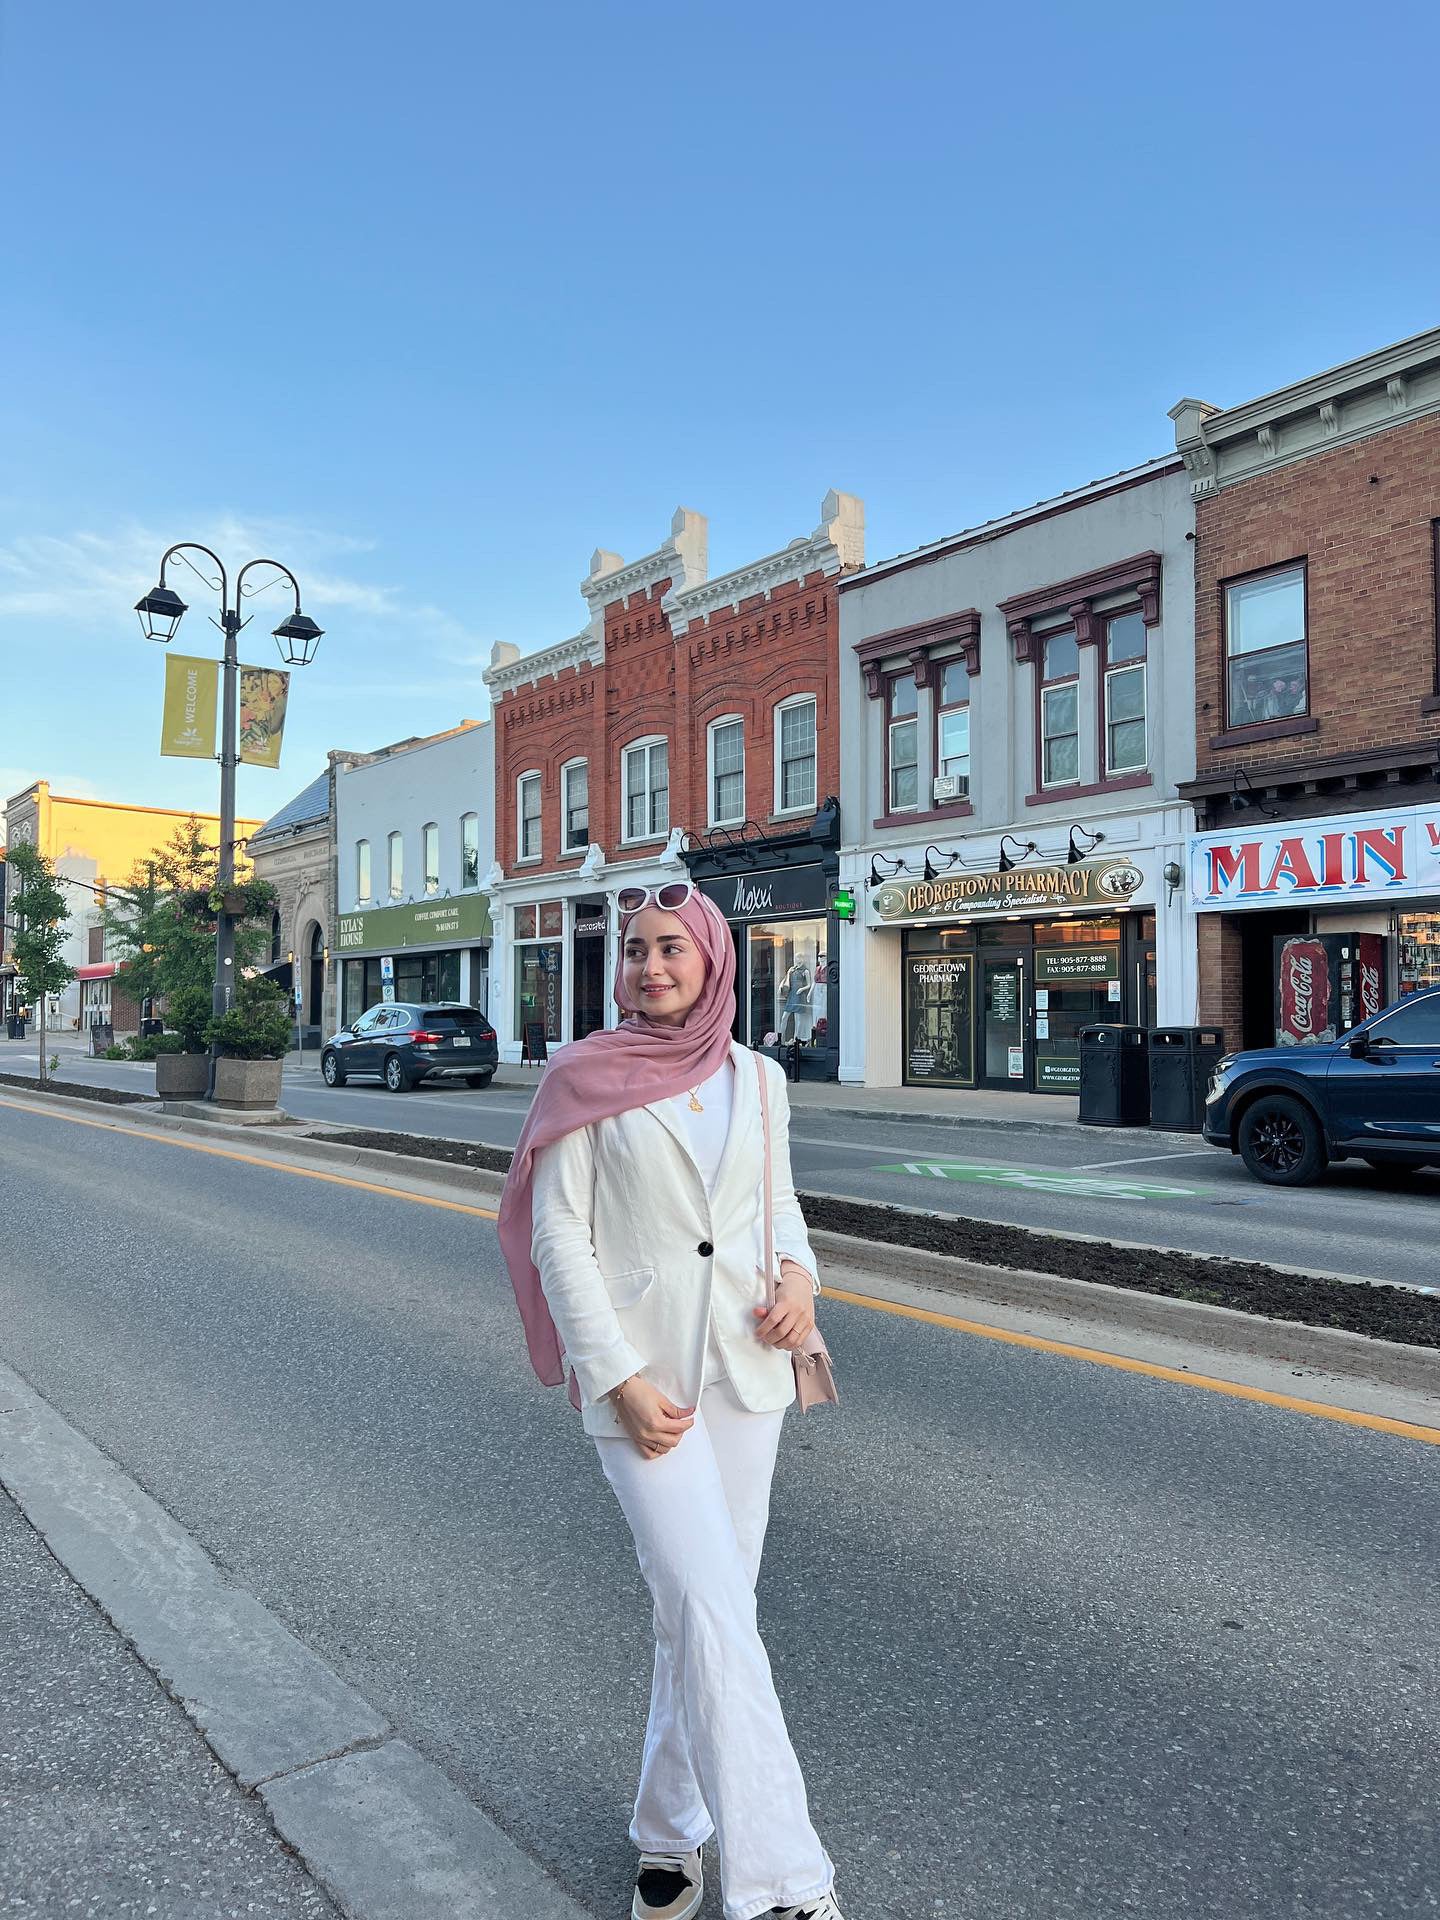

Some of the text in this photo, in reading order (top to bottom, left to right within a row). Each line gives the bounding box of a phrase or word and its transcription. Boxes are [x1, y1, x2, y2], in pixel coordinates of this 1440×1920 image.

[184, 668, 198, 724] WELCOME
[1206, 826, 1408, 899] MAIN
[733, 877, 773, 916] Moxxi
[907, 869, 1093, 914] GEORGETOWN PHARMACY
[775, 902, 803, 911] BOUTIQUE
[944, 893, 1048, 913] & Compounding Specialists
[340, 917, 364, 933] LYLA'S
[340, 932, 364, 947] HOUSE
[1046, 955, 1107, 965] TEL: 905-877-8888
[913, 963, 966, 973] GEORGETOWN
[1047, 964, 1106, 973] FAX: 905-877-8188
[919, 973, 960, 983] PHARMACY
